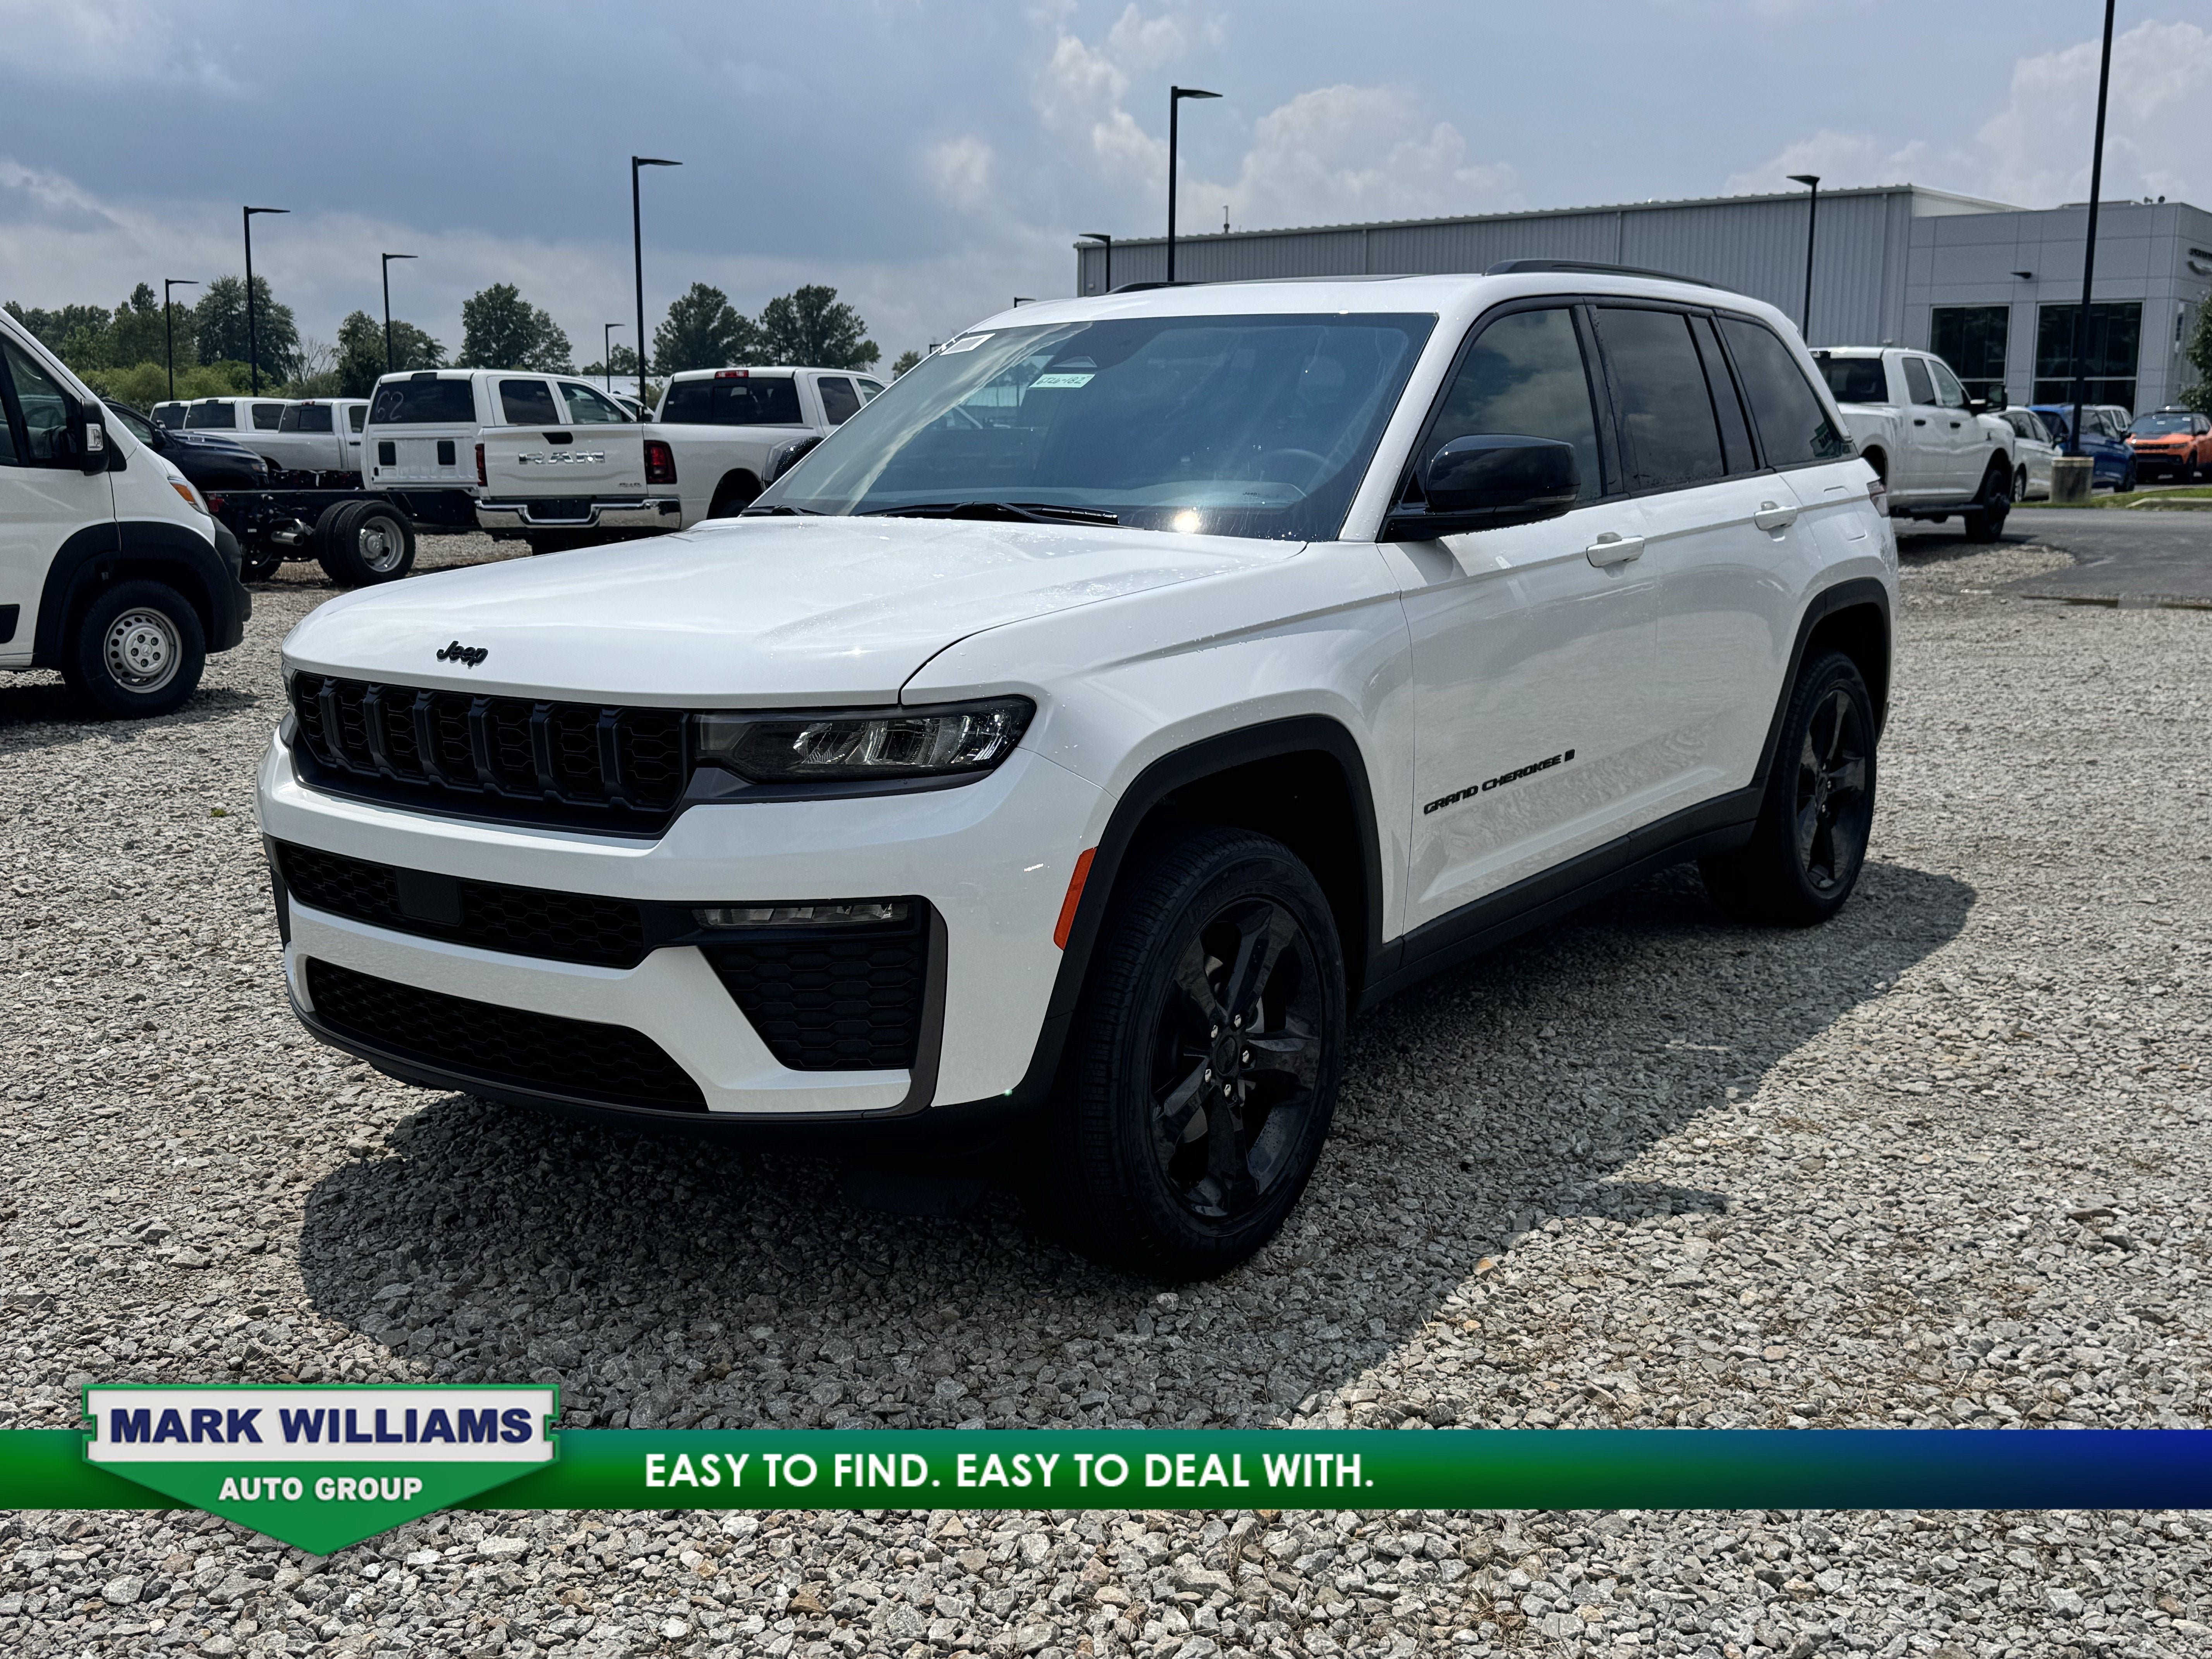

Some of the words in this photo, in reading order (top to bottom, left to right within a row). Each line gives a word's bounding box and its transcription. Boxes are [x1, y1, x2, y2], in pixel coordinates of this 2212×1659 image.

[375, 390, 404, 421] 62
[519, 451, 605, 464] RAM
[436, 641, 488, 667] Jeep
[1424, 785, 1479, 814] GRAND
[1482, 754, 1562, 792] CHEROKEE
